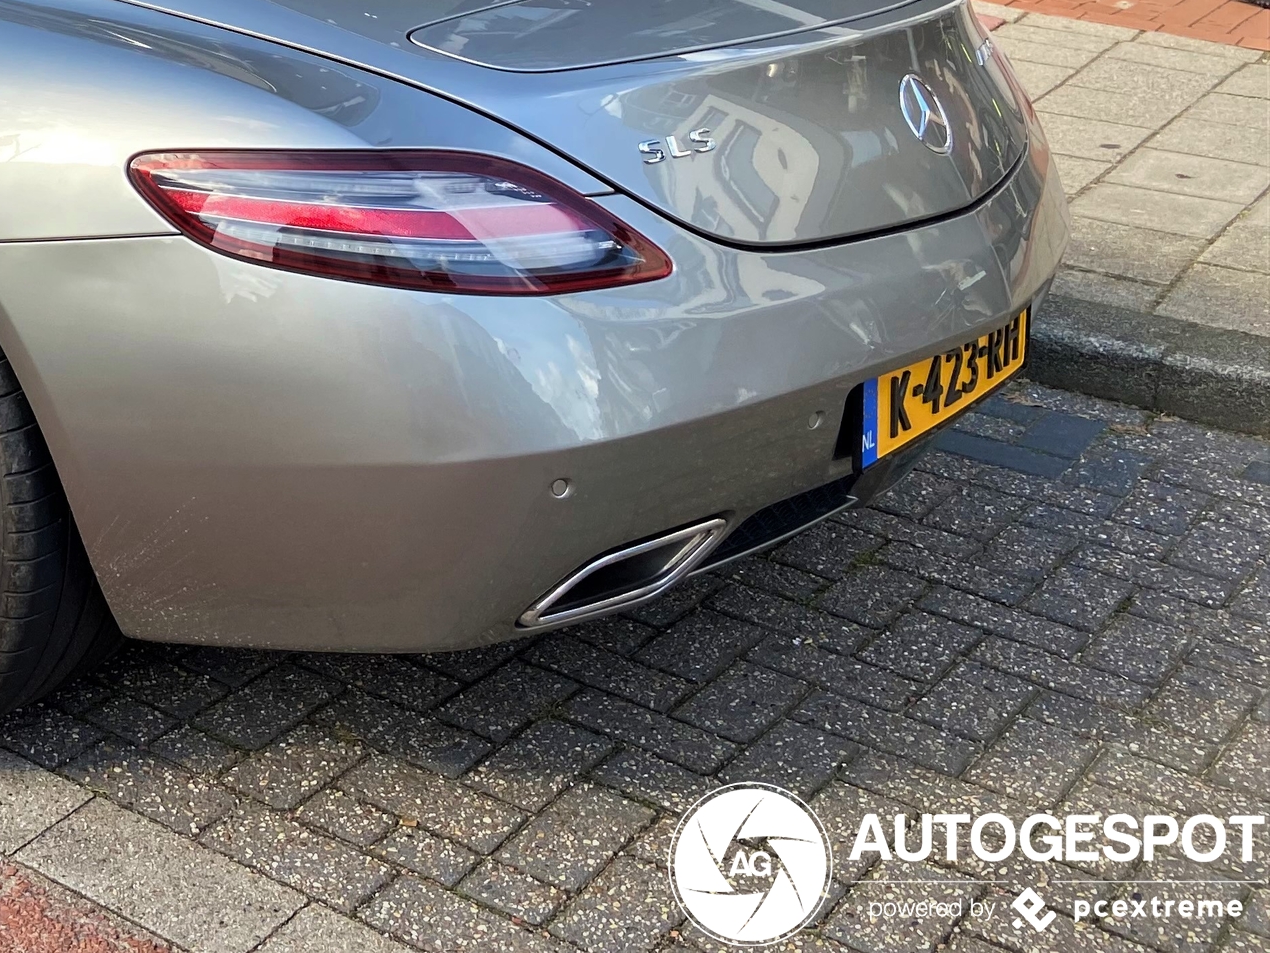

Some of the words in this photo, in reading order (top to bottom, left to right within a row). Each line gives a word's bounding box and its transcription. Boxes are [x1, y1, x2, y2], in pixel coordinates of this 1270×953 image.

[638, 127, 717, 165] SLS
[889, 316, 1020, 439] K-423-RH
[862, 429, 876, 453] NL
